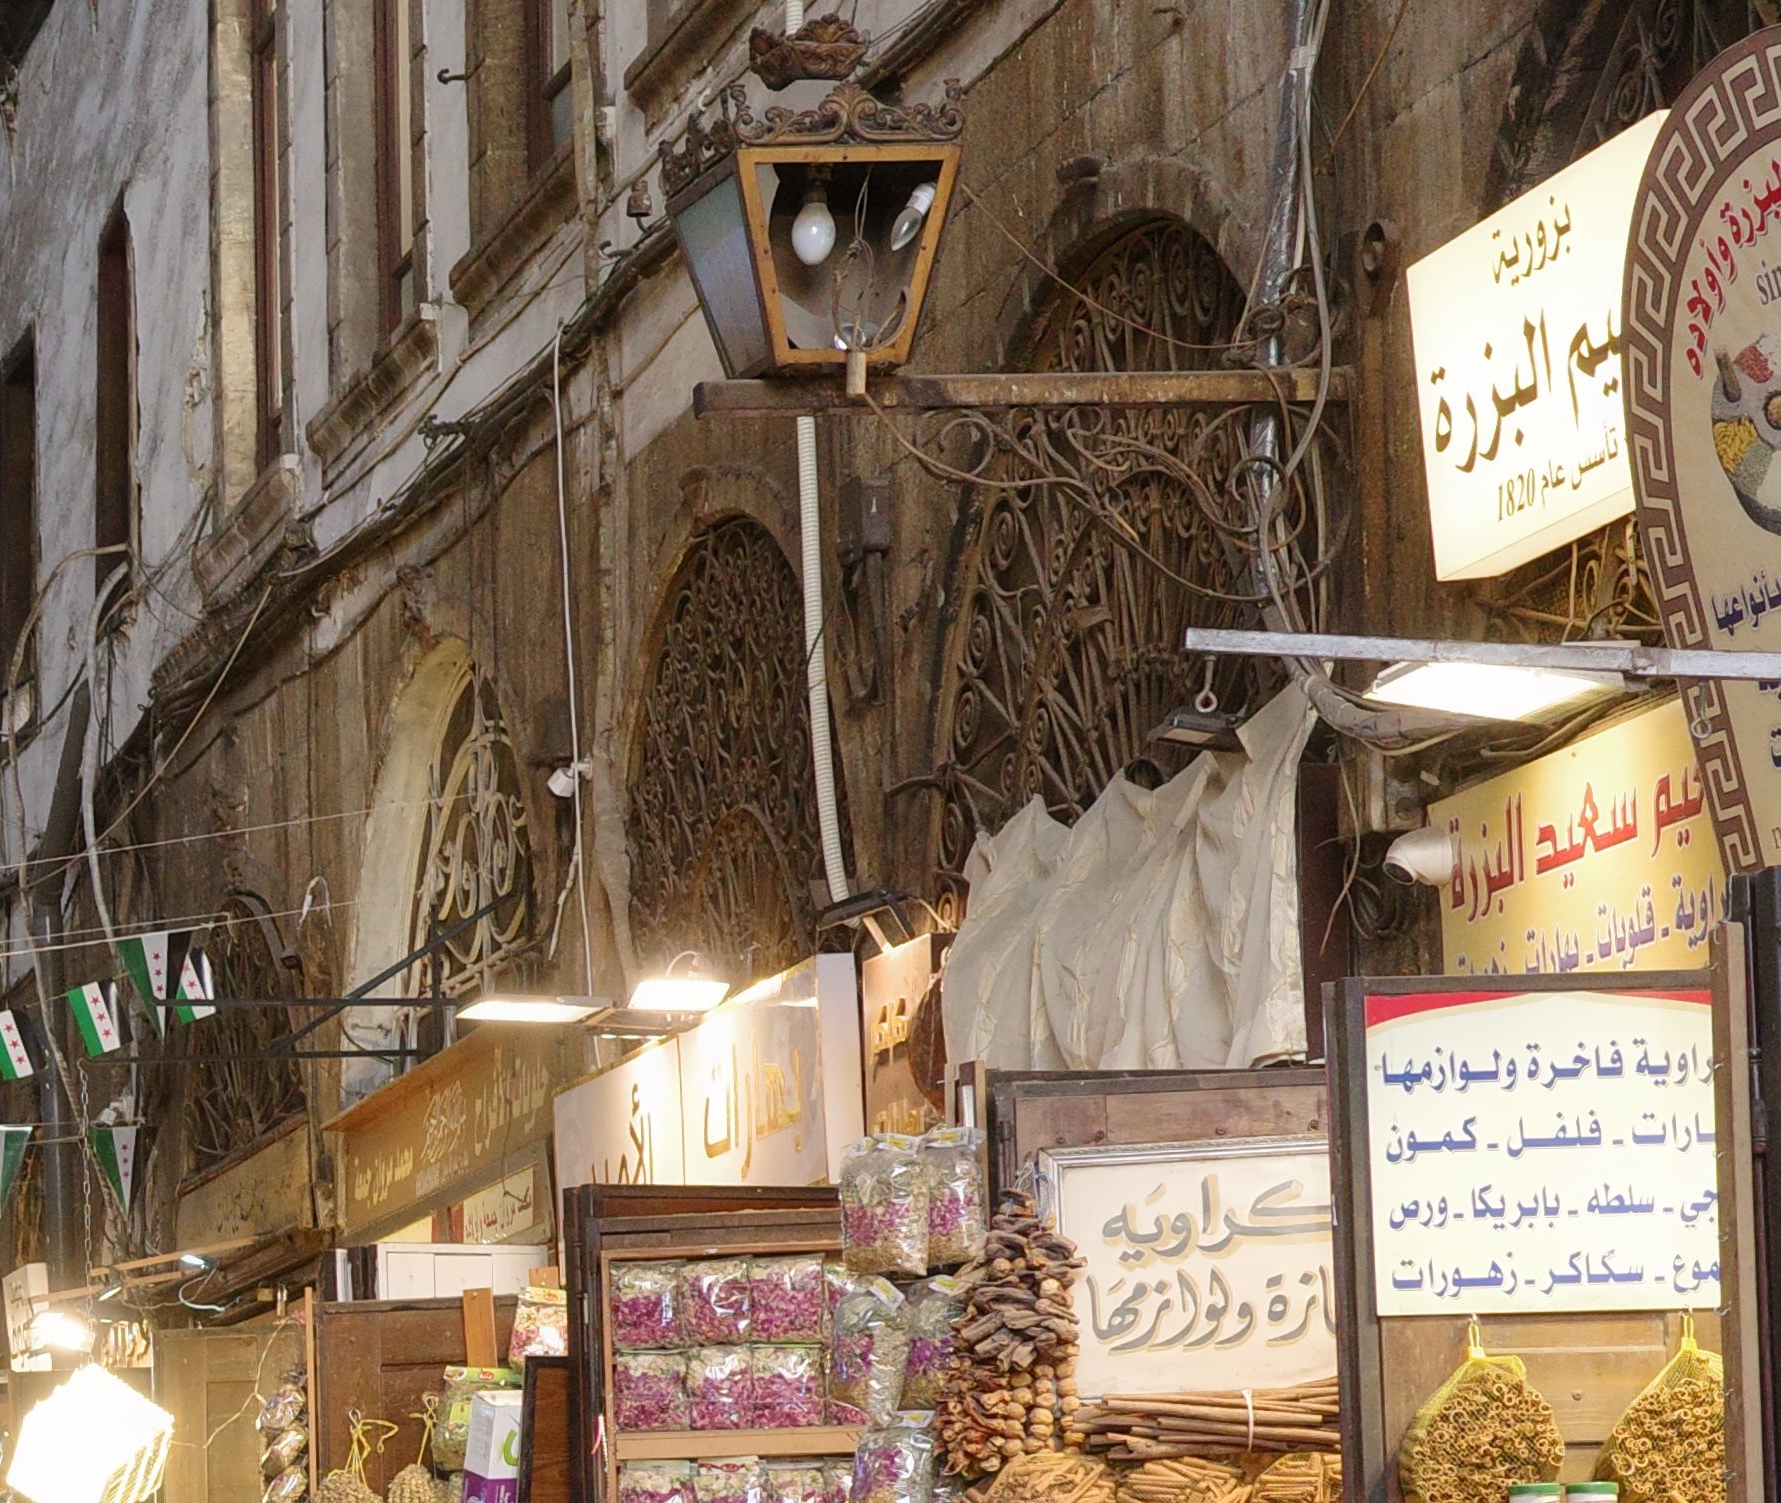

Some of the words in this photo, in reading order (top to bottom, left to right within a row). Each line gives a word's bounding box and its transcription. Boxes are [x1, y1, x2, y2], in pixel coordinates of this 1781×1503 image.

[1492, 195, 1572, 287] بزورية
[1431, 307, 1555, 474] البزرة
[1567, 307, 1622, 431] يم
[1497, 481, 1536, 523] 1820
[1540, 459, 1566, 510] عام
[1450, 792, 1525, 924] البزرة
[1536, 783, 1638, 889] سعيد
[1381, 1046, 1519, 1094] ولوازمها
[1526, 1039, 1626, 1088] فاخرة
[703, 1032, 803, 1181] بهارات
[1632, 1110, 1716, 1152] ارات
[1385, 1115, 1478, 1163] كمون
[1507, 1109, 1602, 1158] فلفل
[1389, 1194, 1448, 1229] ورص
[1472, 1184, 1560, 1230] بابريكا
[1586, 1182, 1656, 1216] سلطه
[1391, 1250, 1518, 1298] زهورات
[1539, 1249, 1644, 1294] سكاكر
[1087, 1265, 1255, 1355] ولوازمها
[1267, 1265, 1336, 1346] ازة
